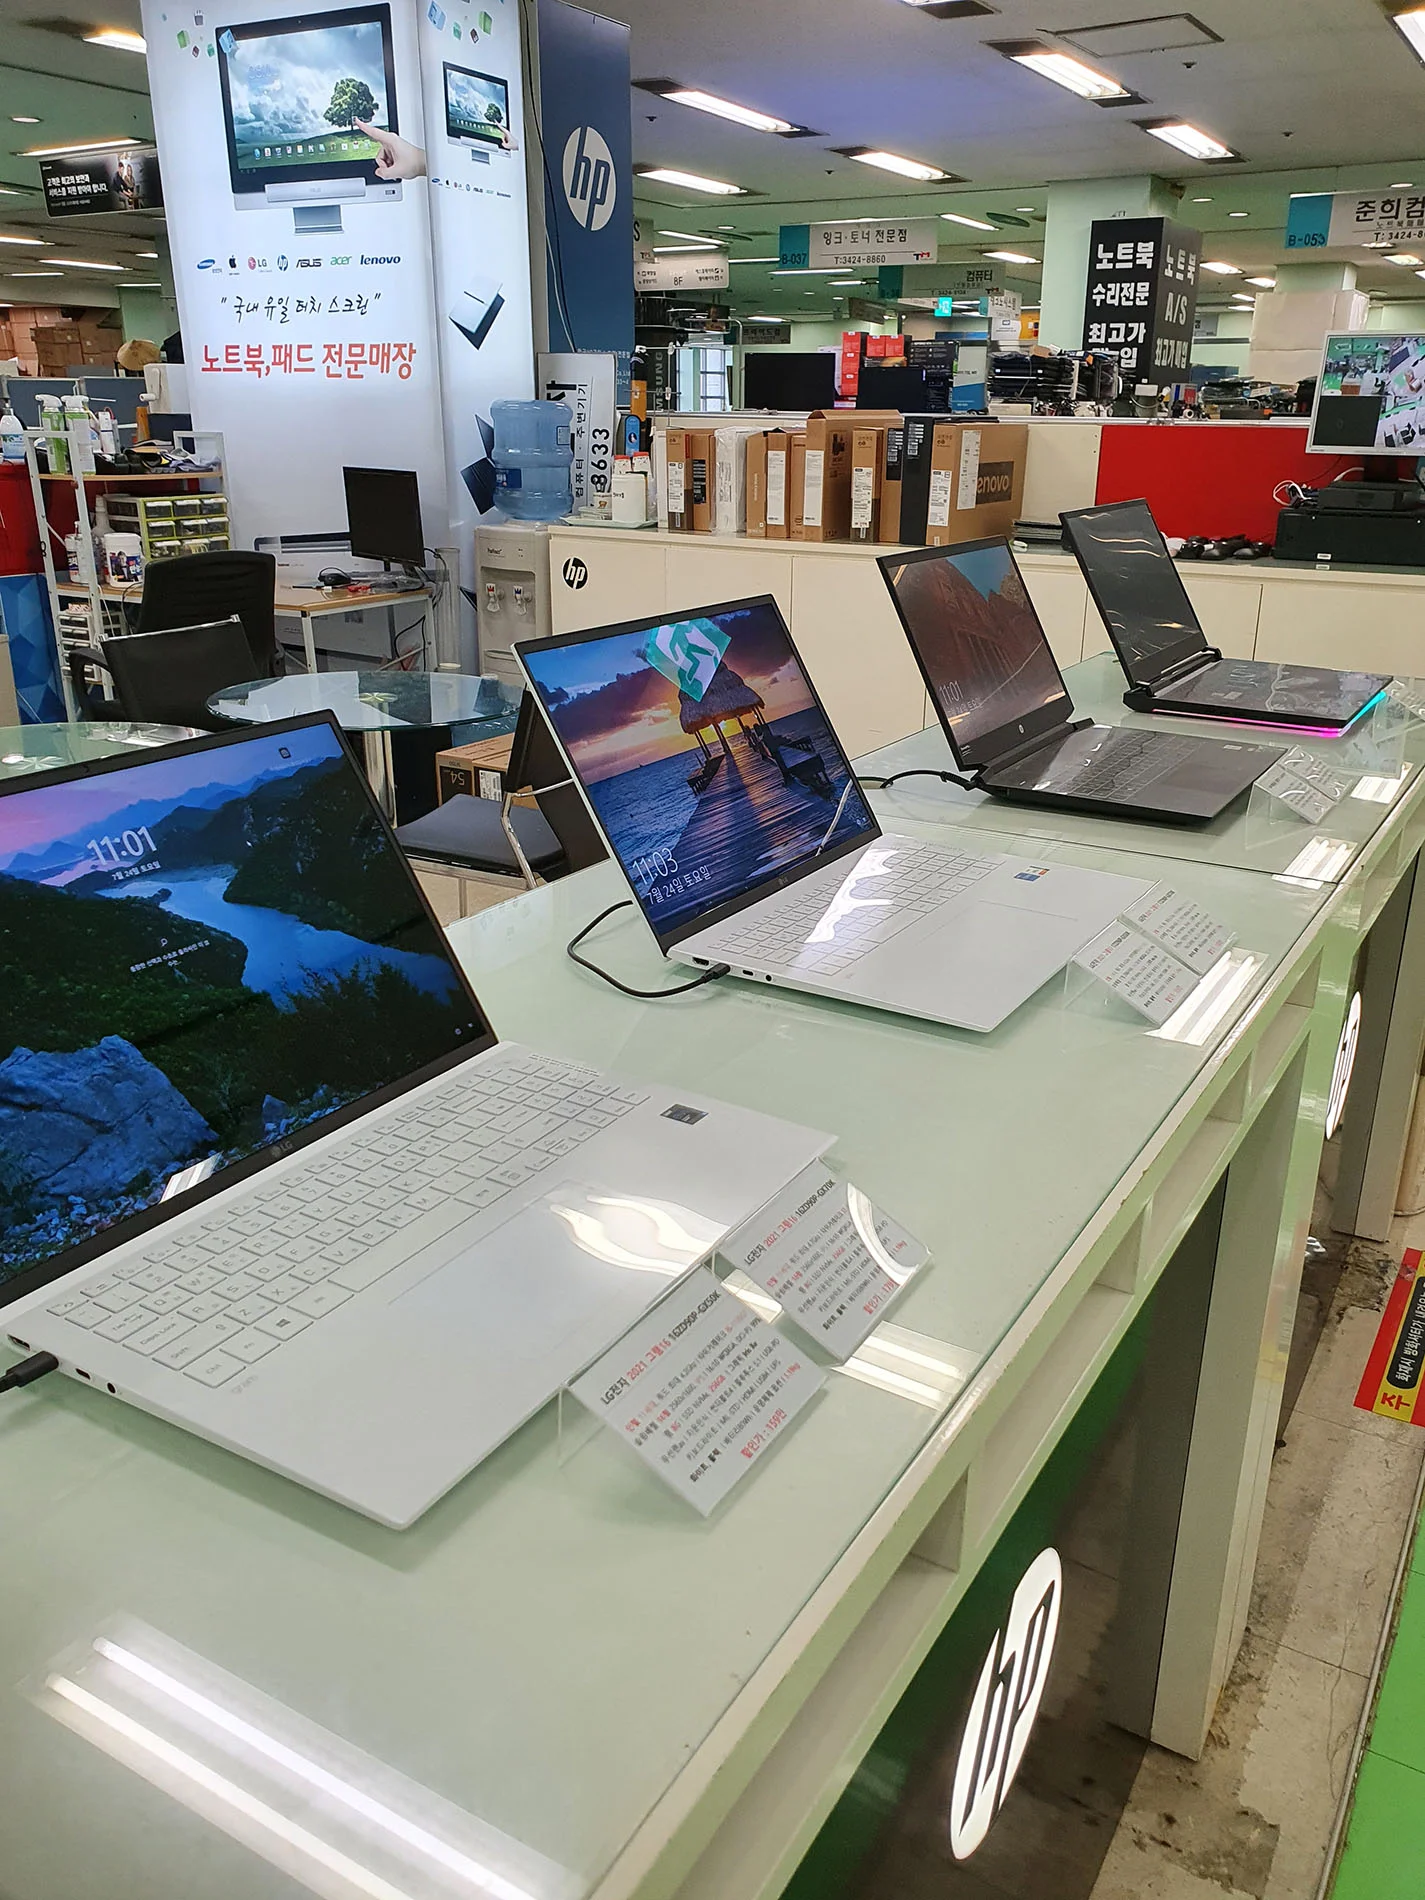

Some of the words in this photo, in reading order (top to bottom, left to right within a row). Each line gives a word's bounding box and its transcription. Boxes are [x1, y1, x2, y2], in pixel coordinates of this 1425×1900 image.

[565, 126, 615, 231] hp
[823, 230, 871, 246] 잉크·토너
[875, 228, 908, 244] 전문점
[257, 259, 268, 268] LG
[296, 258, 323, 268] ASUS
[330, 256, 352, 266] acer
[360, 254, 402, 266] lenovo
[1095, 241, 1155, 270] 노트북
[1164, 244, 1198, 286] 노트북
[673, 276, 684, 286] 8F
[966, 269, 993, 282] 컴퓨터
[264, 296, 290, 324] 유일
[296, 295, 322, 314] 터치
[1092, 282, 1150, 308] 수리전문
[1164, 292, 1188, 326] A/S
[1088, 322, 1147, 344] 최고가
[201, 344, 316, 379] 노트북,패드
[322, 342, 417, 380] 전문매장
[1091, 347, 1138, 369] 입
[656, 351, 664, 411] MSUNG
[576, 384, 588, 439] 주변기기
[576, 458, 584, 498] 컴퓨터
[976, 474, 1010, 494] enovo
[564, 557, 588, 590] hp
[940, 680, 964, 706] 11:01
[86, 826, 158, 866] 11:01
[112, 872, 124, 881] 7월
[125, 866, 140, 878] 24일
[140, 860, 162, 873] 토요일
[632, 848, 678, 886] 11:03
[646, 887, 664, 905] 7월
[662, 878, 685, 898] 24일
[683, 864, 712, 888] 토요일
[743, 1243, 766, 1266] LG전자
[762, 1230, 781, 1247] 2021
[598, 1375, 630, 1405] LG전자
[625, 1359, 648, 1381] 2021
[643, 1336, 672, 1363] 그램16
[667, 1289, 722, 1341] 16ZD90P-GX50K
[1395, 1357, 1416, 1383] 화재시
[1380, 1392, 1411, 1410] 주
[739, 1432, 766, 1460] 할인가
[763, 1407, 787, 1432] 159만
